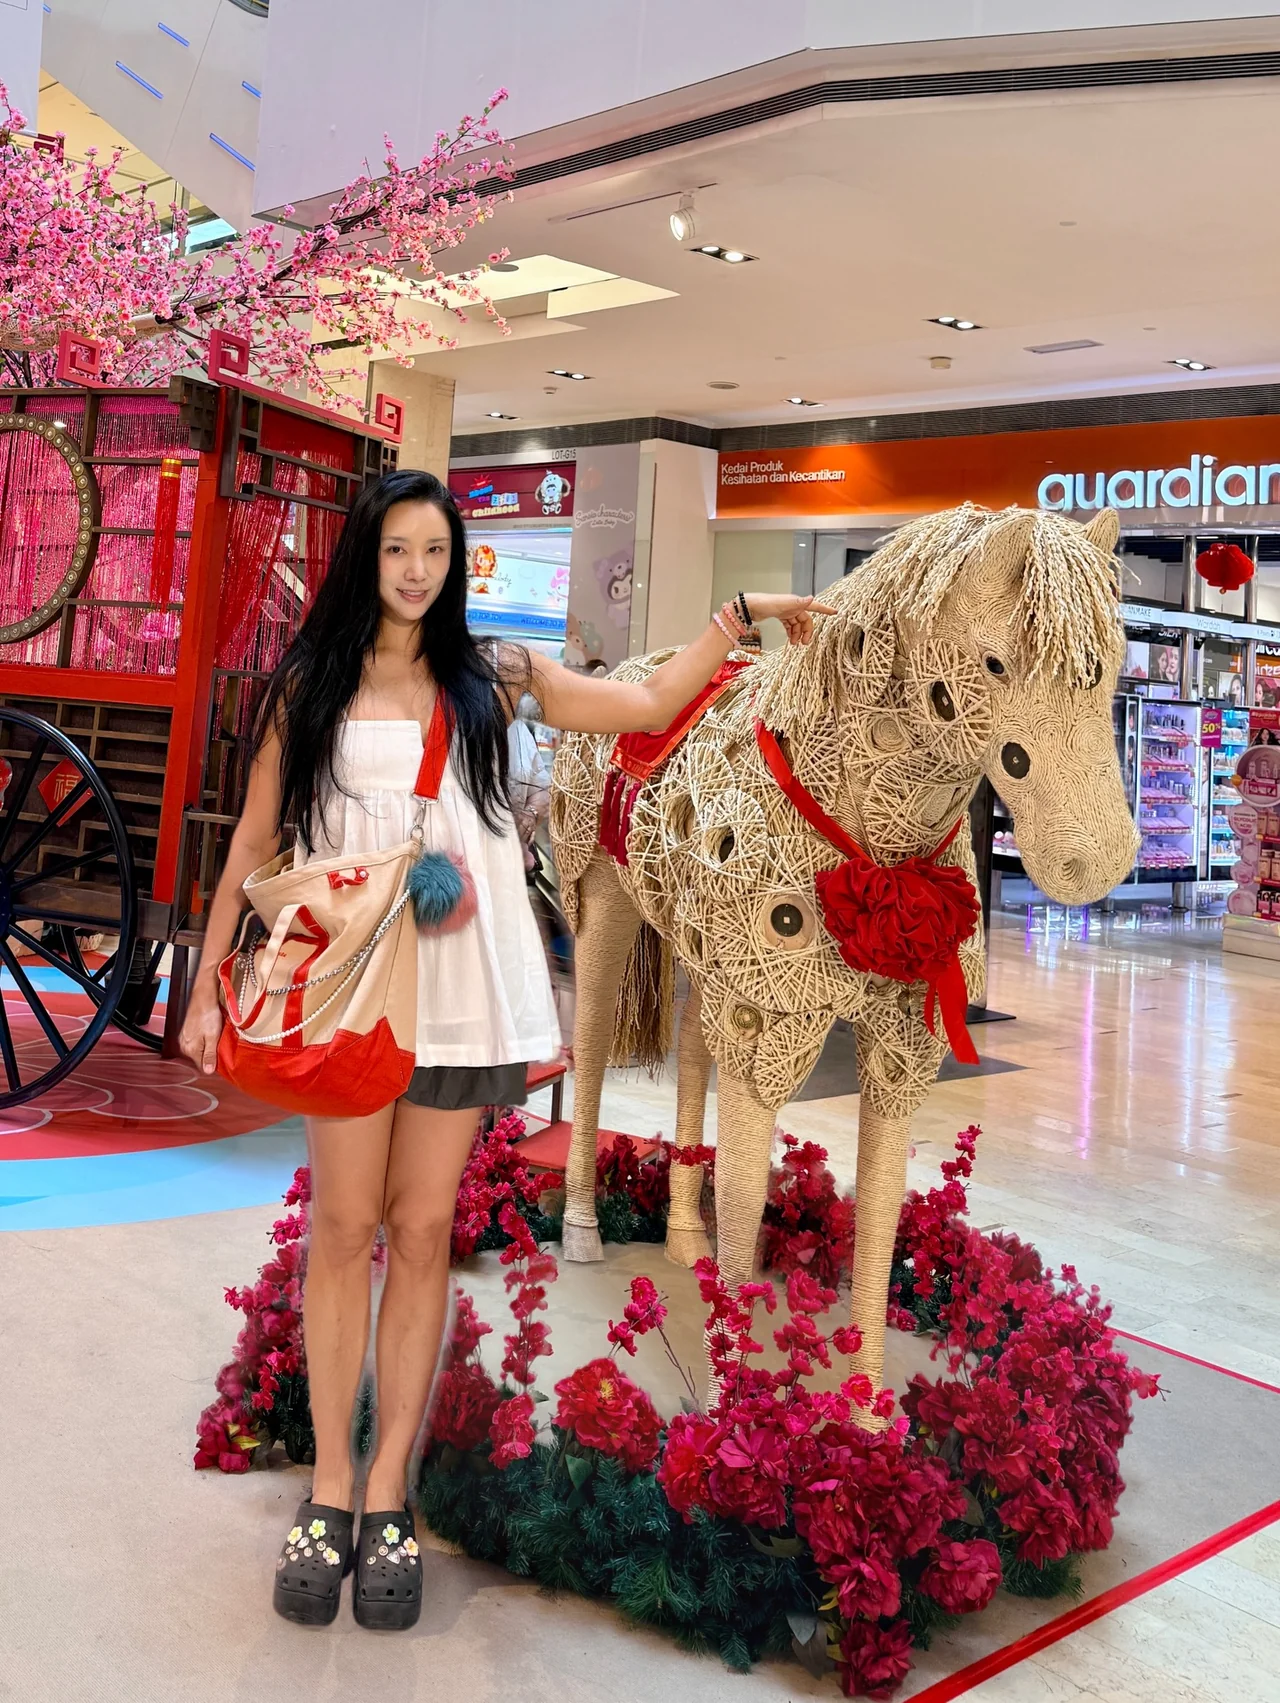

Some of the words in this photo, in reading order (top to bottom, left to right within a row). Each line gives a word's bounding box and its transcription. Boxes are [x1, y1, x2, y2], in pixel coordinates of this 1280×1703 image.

[552, 449, 576, 460] LOT-G15
[721, 461, 748, 474] Kedai
[750, 460, 783, 472] Produk
[721, 473, 768, 485] Kesihatan
[769, 471, 788, 482] dan
[789, 469, 845, 482] Kecantikan
